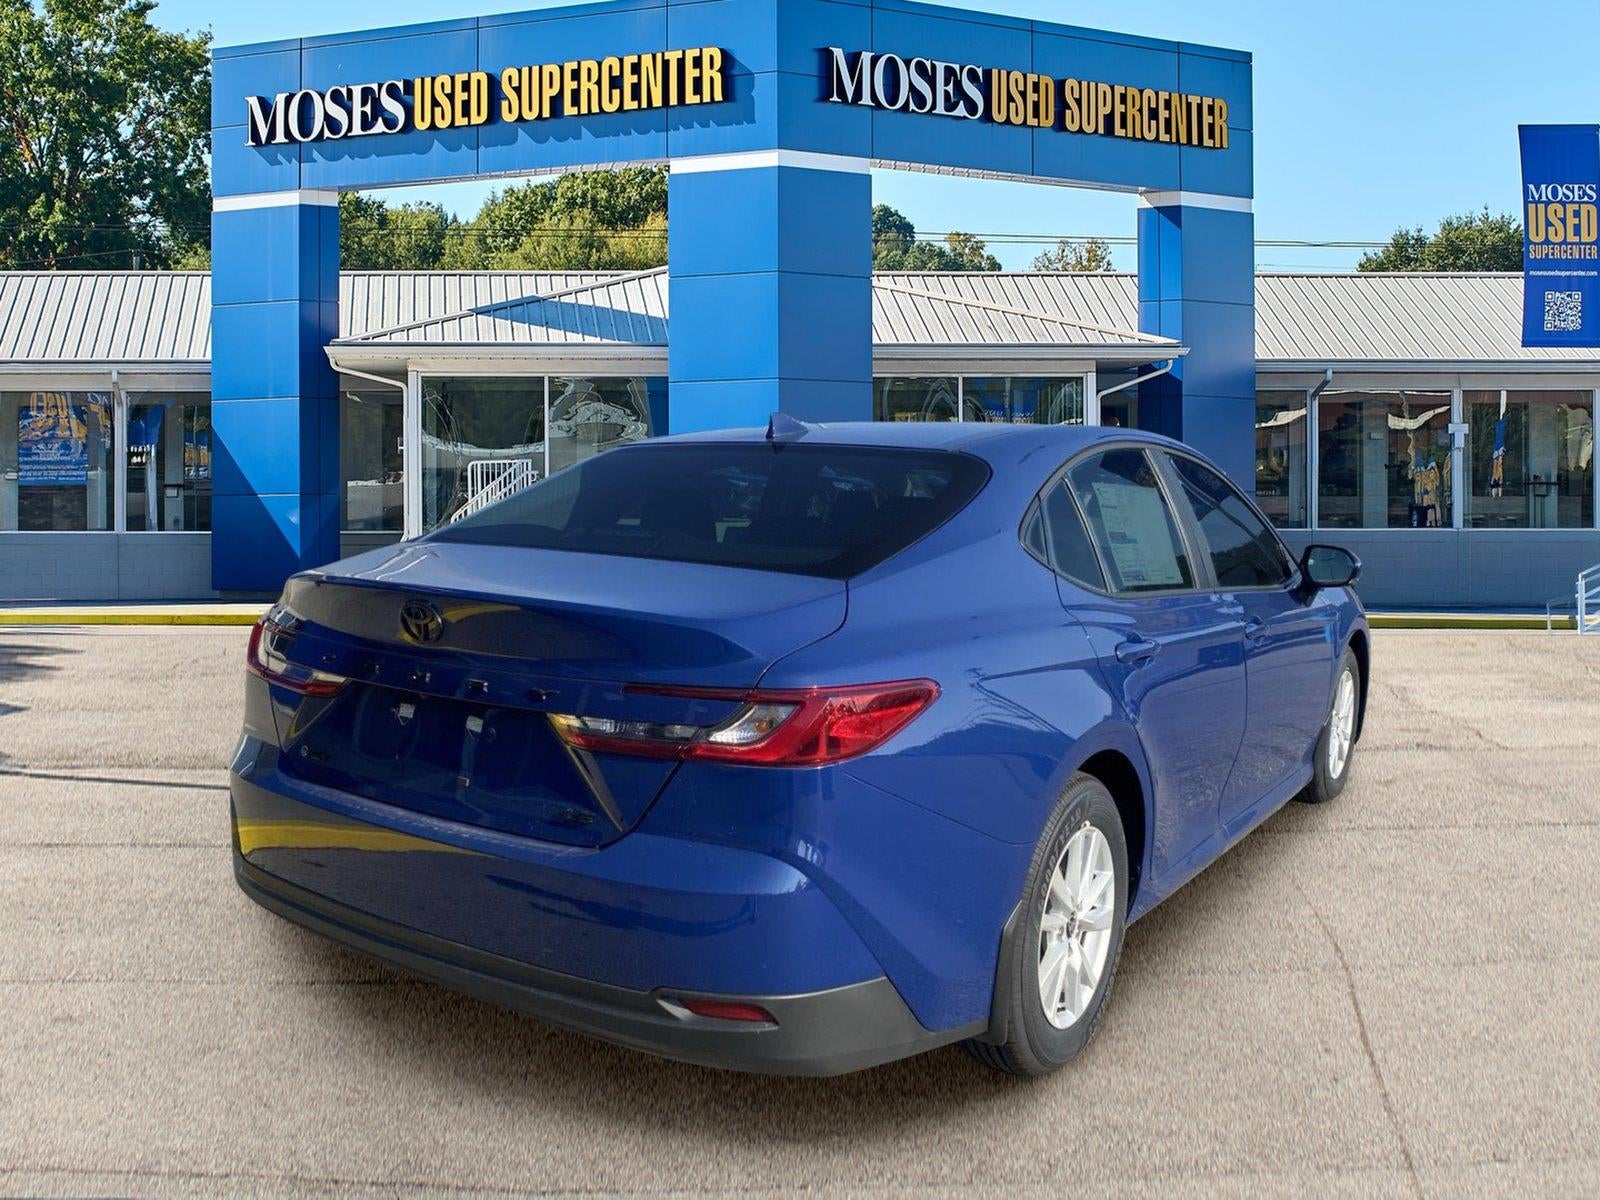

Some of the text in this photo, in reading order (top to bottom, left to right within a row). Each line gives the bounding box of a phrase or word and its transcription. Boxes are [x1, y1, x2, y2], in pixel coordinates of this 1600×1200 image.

[245, 45, 725, 147] MOSES USED SUPERCENTER
[828, 46, 1230, 150] MOSES USED SUPERCENTER
[1528, 183, 1597, 202] MOSES
[1528, 203, 1598, 243] USED
[1529, 245, 1598, 259] SUPERCENTER
